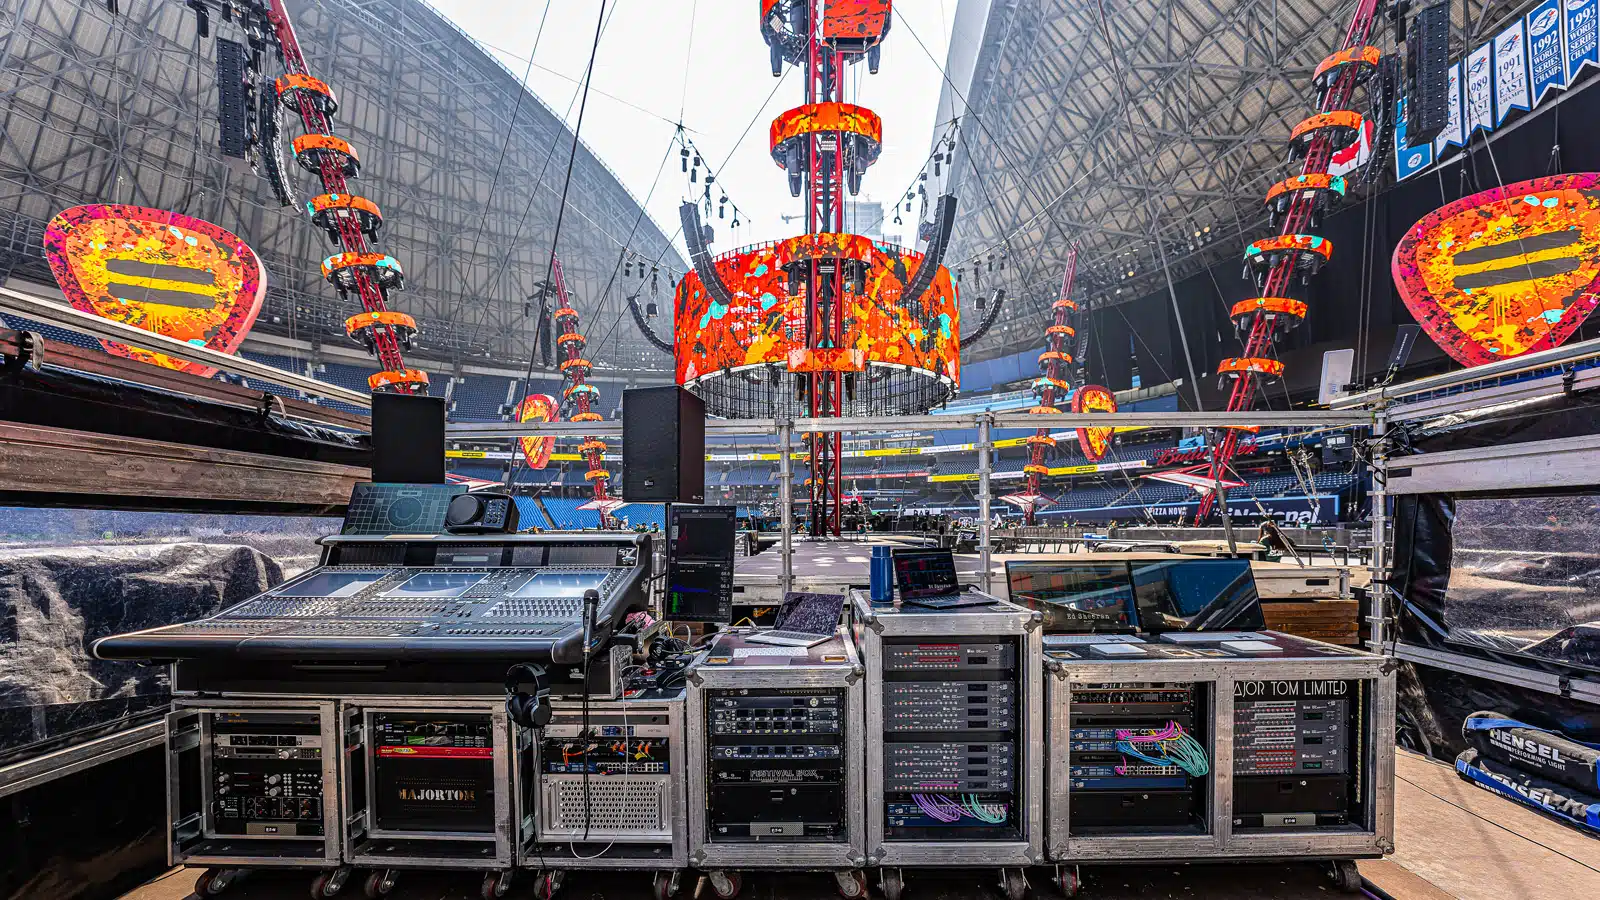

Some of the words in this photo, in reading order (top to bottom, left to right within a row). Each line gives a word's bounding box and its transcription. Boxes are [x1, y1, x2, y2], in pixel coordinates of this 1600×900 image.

[1568, 4, 1596, 30] 1993
[1568, 20, 1596, 41] WORLD
[1532, 33, 1558, 55] 1992
[1569, 32, 1596, 52] SERIES
[1569, 41, 1596, 62] CHAMPS
[1533, 45, 1559, 65] WORLD
[1497, 57, 1521, 78] 1991
[1534, 56, 1560, 74] SERIES
[1535, 66, 1562, 85] CHAMPS
[1468, 76, 1488, 95] 989
[1499, 80, 1523, 98] EAST
[1499, 89, 1524, 106] CHAMPS
[1148, 507, 1167, 516] PIZZA
[1066, 612, 1077, 620] Ed
[1077, 612, 1110, 620] Sheeran
[1233, 681, 1265, 698] AJOR
[1270, 681, 1299, 696] TOM
[1303, 681, 1347, 696] LIMITED
[1489, 728, 1566, 764] HENSEL
[1511, 748, 1547, 766] PERFORMING
[1547, 760, 1566, 771] LIGHT
[750, 769, 795, 778] FESTIVAL
[796, 769, 818, 778] BOX
[399, 788, 476, 801] MAJORTOM
